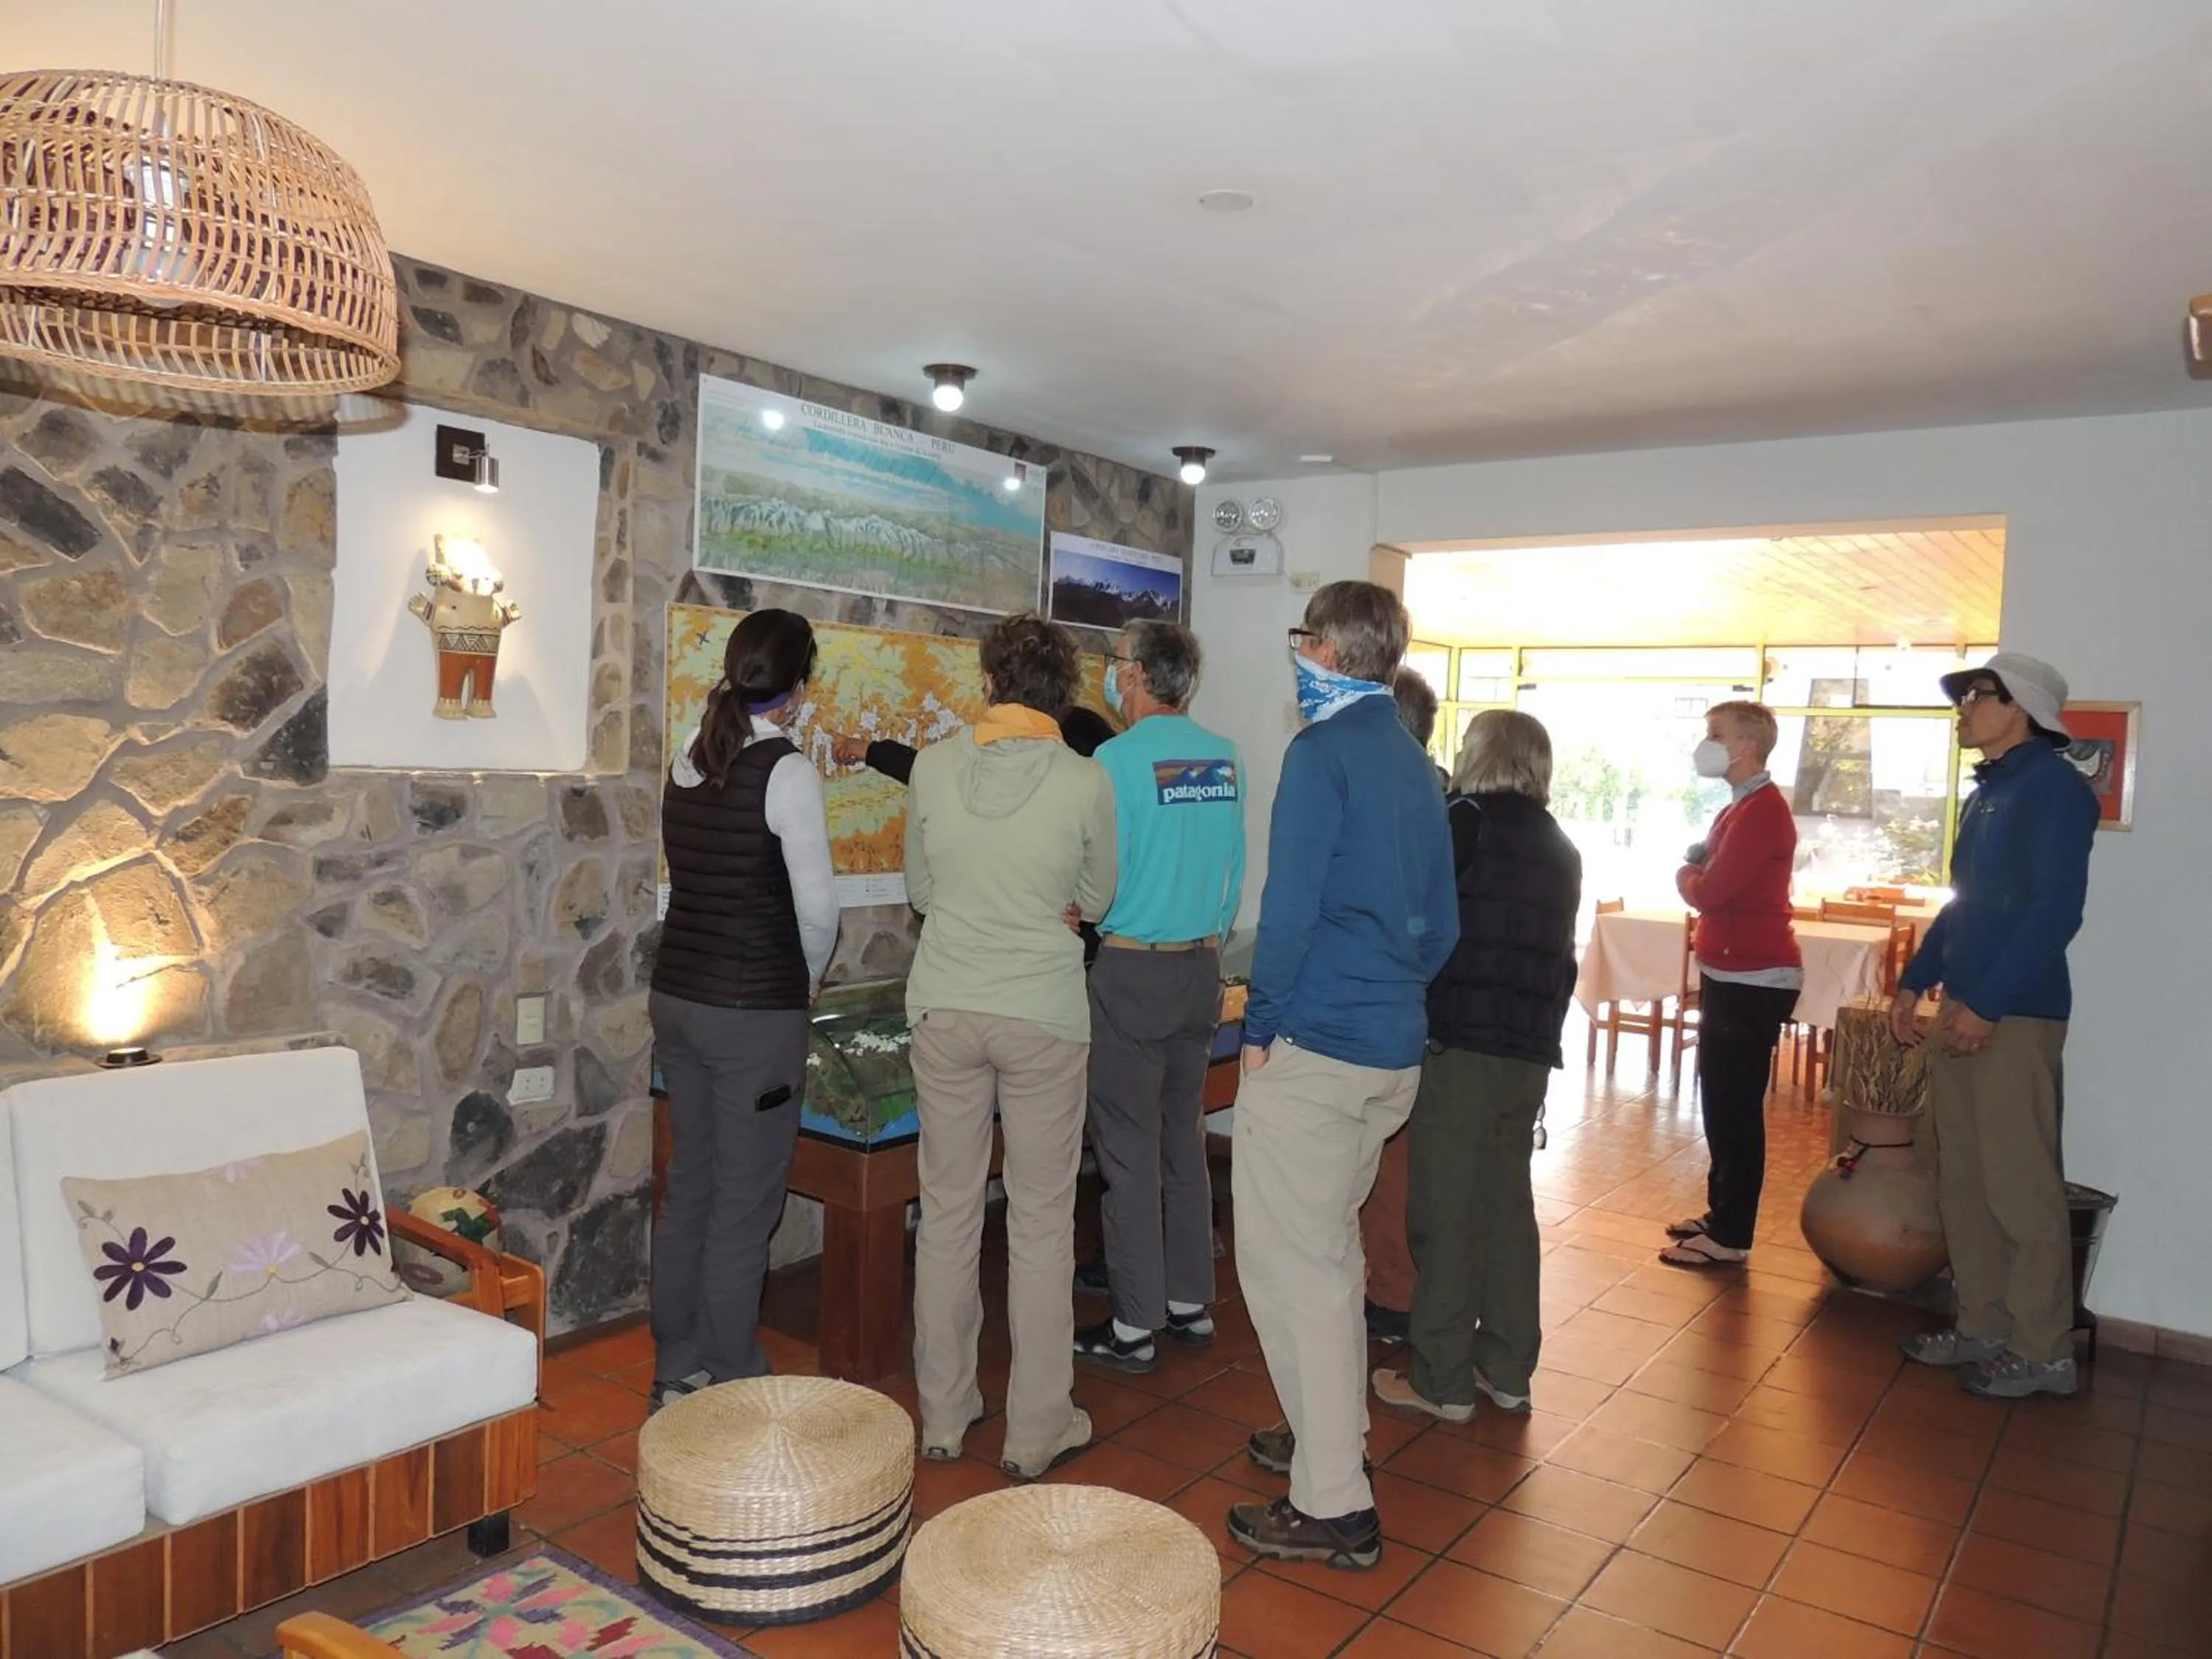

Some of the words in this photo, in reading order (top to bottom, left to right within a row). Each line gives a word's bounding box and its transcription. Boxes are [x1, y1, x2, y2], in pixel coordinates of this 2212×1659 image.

[801, 404, 866, 431] CORDILLERA
[873, 423, 914, 442] BLANCA
[931, 438, 956, 454] PERU
[1163, 782, 1235, 802] patagonia
